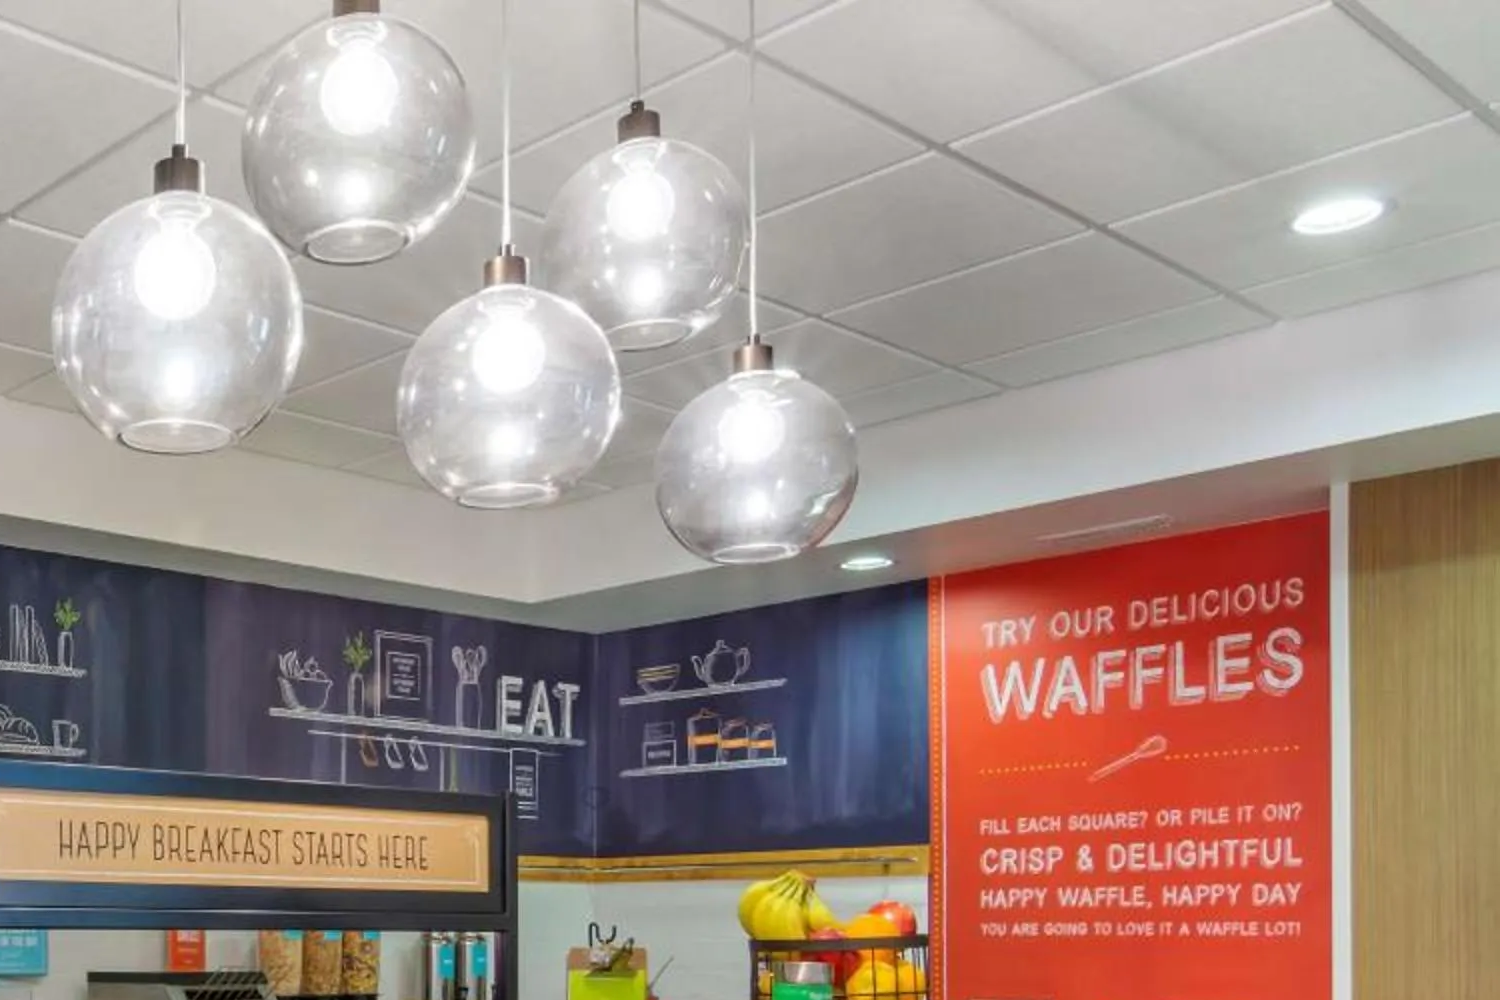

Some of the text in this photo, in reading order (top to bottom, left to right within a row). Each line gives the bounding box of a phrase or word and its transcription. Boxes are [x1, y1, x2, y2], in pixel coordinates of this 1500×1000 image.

[982, 577, 1305, 649] TRY OUR DELICIOUS
[980, 626, 1304, 725] WAFFLES
[496, 675, 581, 739] EAT
[980, 802, 1303, 836] FILL EACH SQUARE? OR PILE IT ON?
[59, 819, 429, 871] HAPPY BREAKFAST STARTS HERE
[980, 838, 1302, 875] CRISP & DELIGHTFUL
[980, 882, 1302, 909] HAPPY WAFFLE, HAPPY DAY
[980, 922, 1007, 937] YOU
[1011, 922, 1039, 936] ARE
[1044, 921, 1088, 936] GOING
[1094, 921, 1111, 936] TO
[1117, 922, 1154, 936] LOVE
[1160, 921, 1172, 936] IT
[1179, 922, 1190, 936] A
[1197, 921, 1258, 936] WAFFLE
